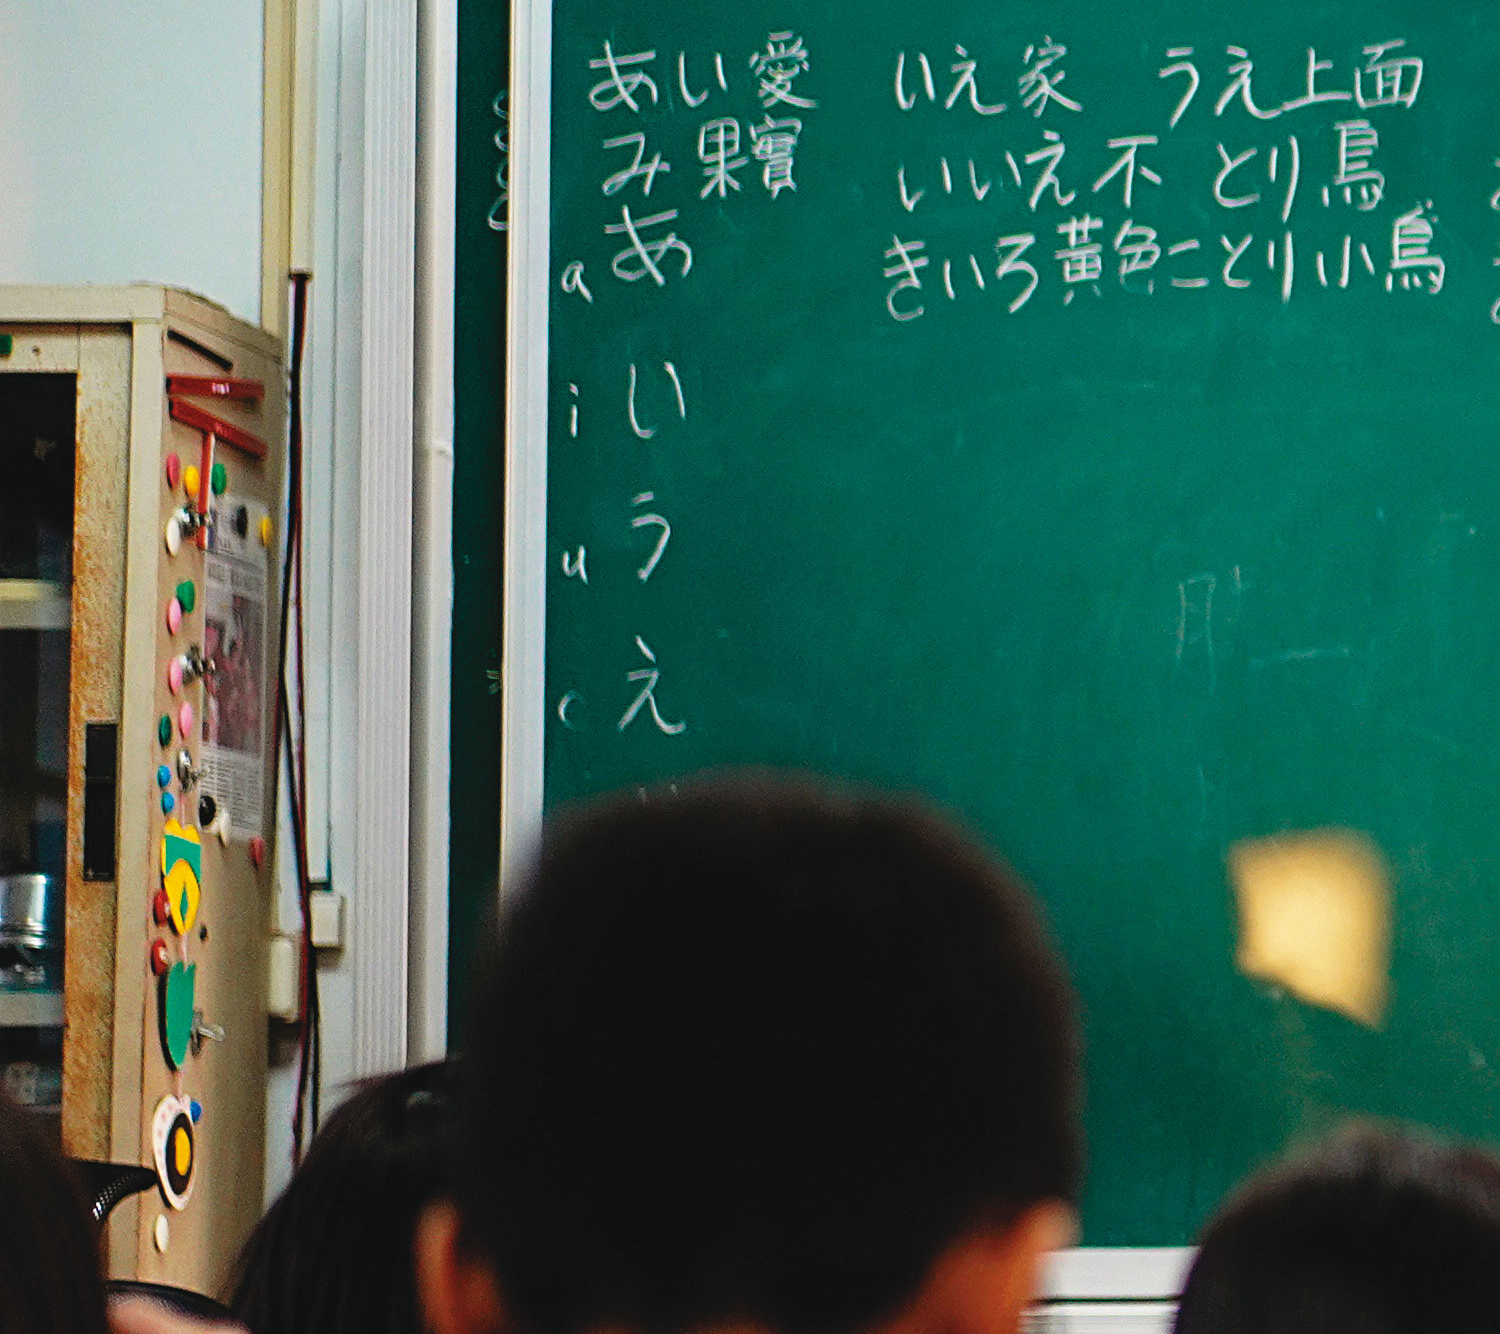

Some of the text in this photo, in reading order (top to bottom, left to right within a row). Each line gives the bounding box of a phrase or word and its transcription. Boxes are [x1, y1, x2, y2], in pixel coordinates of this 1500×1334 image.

[604, 205, 693, 287] あ
[627, 361, 688, 440] い
[630, 490, 672, 583] う
[617, 634, 687, 735] え
